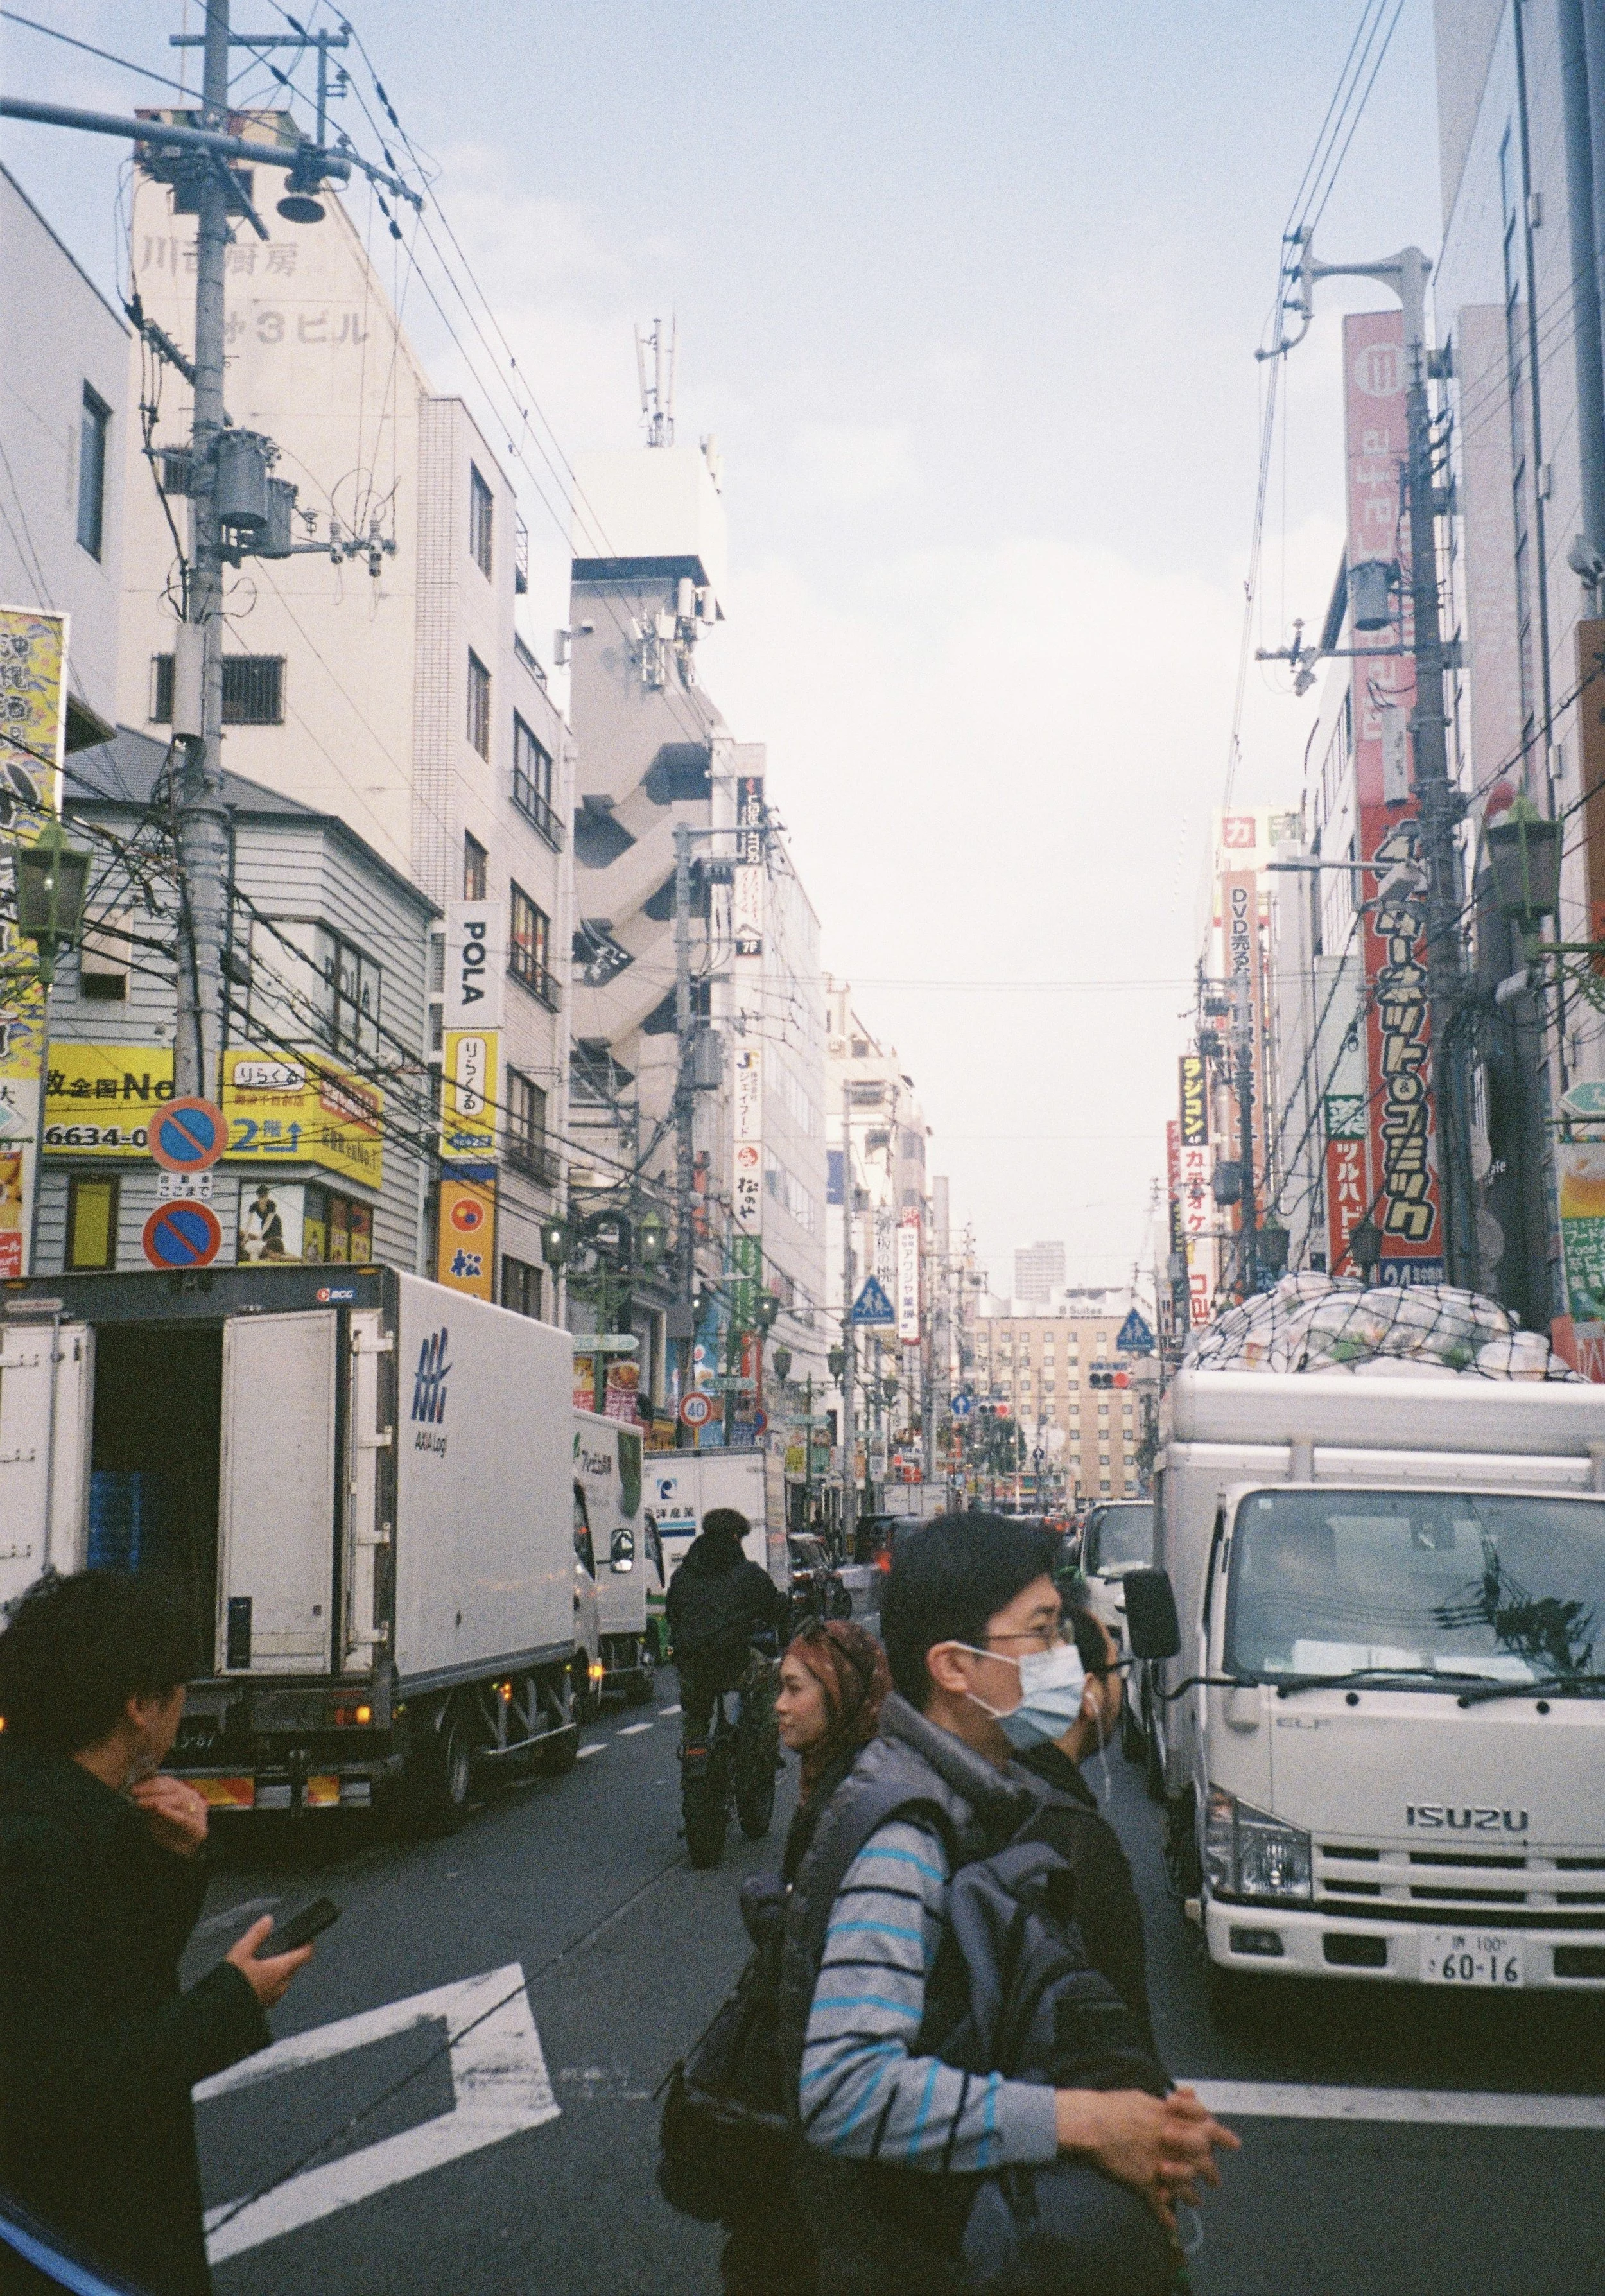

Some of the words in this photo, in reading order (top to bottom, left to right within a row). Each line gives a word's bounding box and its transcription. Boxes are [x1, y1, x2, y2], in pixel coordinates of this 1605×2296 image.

[461, 921, 487, 1006] POLA
[1183, 1059, 1204, 1135] ラジコン
[1328, 1099, 1365, 1136] 薬
[686, 1402, 706, 1418] 40
[1276, 1716, 1332, 1730] ELF
[1406, 1804, 1529, 1832] ISUZU
[1442, 1953, 1518, 1983] 60-16
